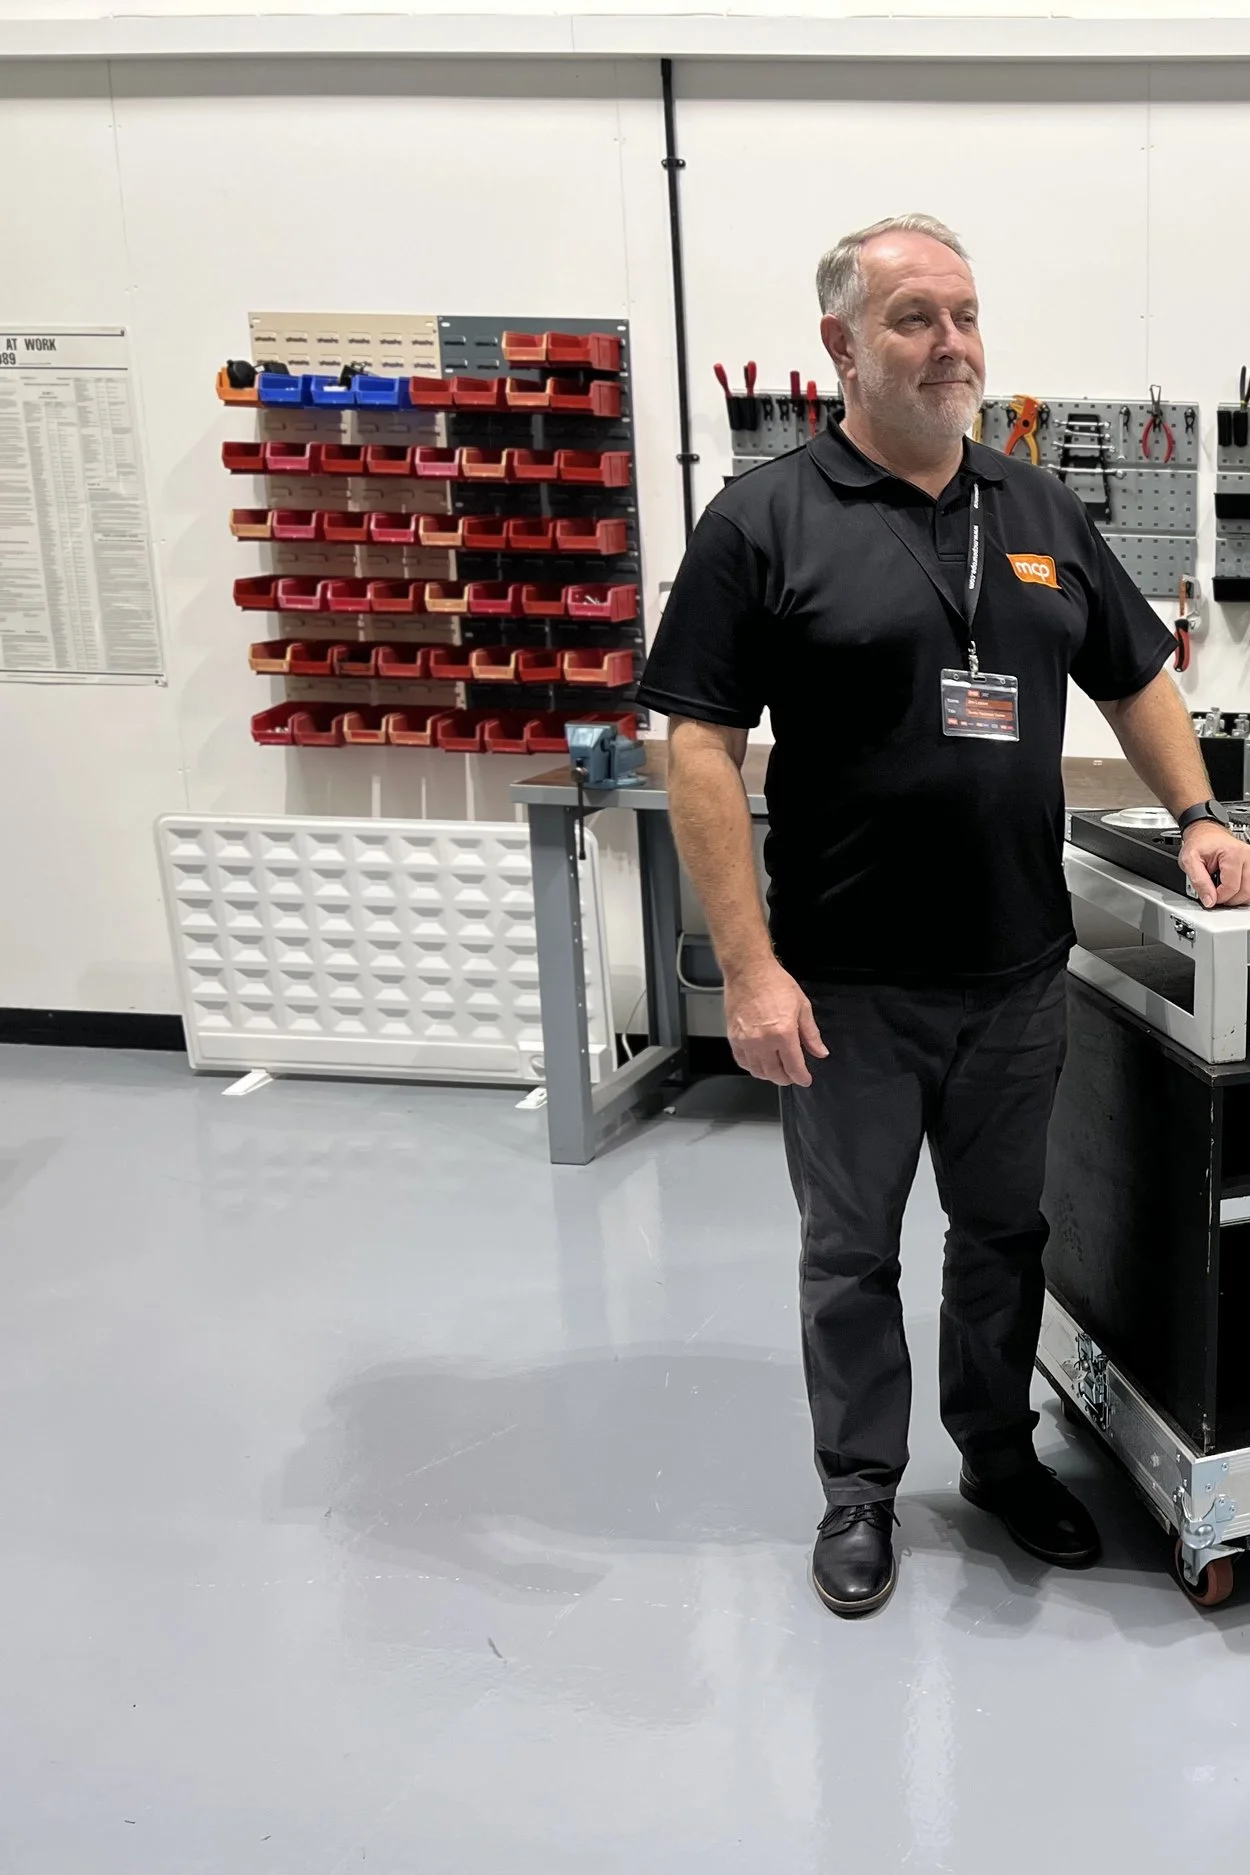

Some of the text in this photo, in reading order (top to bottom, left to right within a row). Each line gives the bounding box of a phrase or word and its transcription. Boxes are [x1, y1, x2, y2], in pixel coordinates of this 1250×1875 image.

[6, 338, 57, 351] AT WORK
[1015, 561, 1050, 582] mcp
